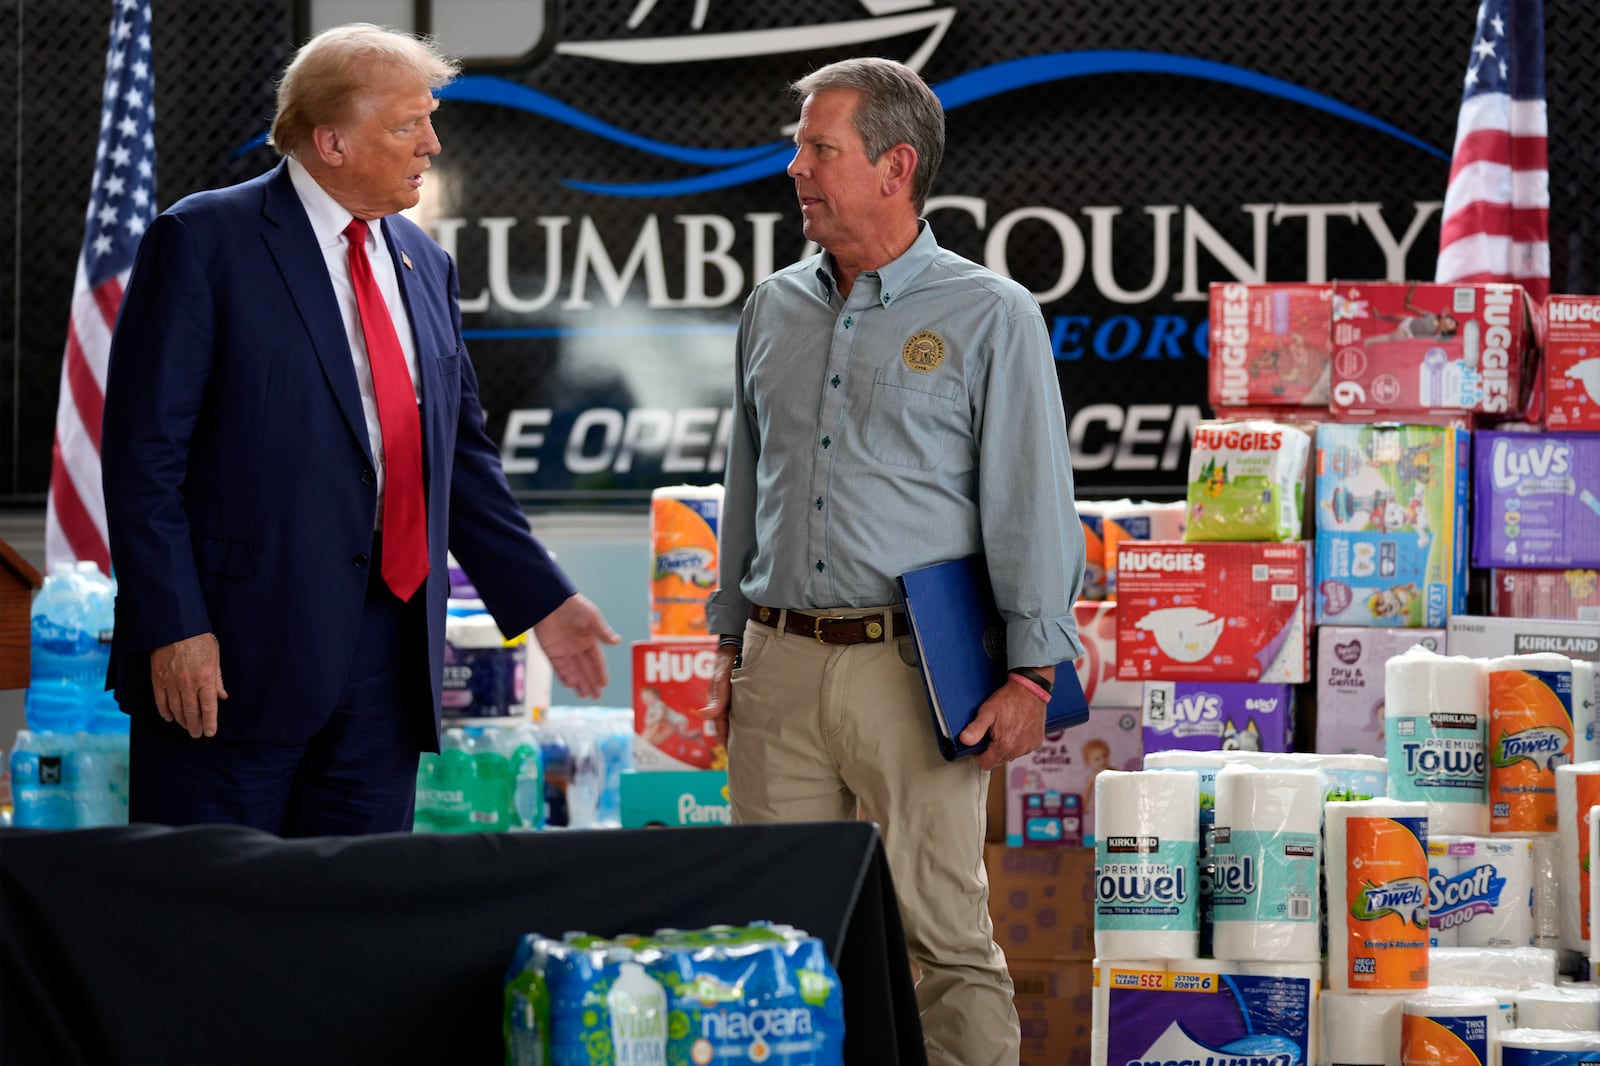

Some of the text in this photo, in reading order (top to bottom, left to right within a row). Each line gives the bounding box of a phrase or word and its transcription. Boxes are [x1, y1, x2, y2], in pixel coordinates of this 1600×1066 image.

[435, 213, 820, 314] LUMBI
[1549, 302, 1600, 322] HUGG
[1221, 285, 1249, 406] HUGGIES
[1483, 283, 1513, 413] HUGGIES
[1334, 381, 1366, 407] 6
[1193, 429, 1282, 451] HUGGIES
[1118, 551, 1205, 572] HUGGIES
[1518, 636, 1599, 653] KIRKLAND
[645, 651, 717, 682] HUG
[1328, 678, 1365, 687] Gentle
[1156, 695, 1220, 732] uvs
[1432, 714, 1476, 724] KIRKLAND
[1427, 739, 1482, 749] PREMIUM
[1502, 736, 1560, 761] Towels
[1403, 743, 1485, 774] Towe
[678, 793, 732, 824] Pam
[1109, 838, 1157, 847] KIRKLAND
[1105, 865, 1166, 875] PREMIUM
[1215, 857, 1253, 890] wel
[1365, 886, 1422, 913] Towels
[1429, 865, 1493, 911] Scott
[1438, 907, 1474, 930] 1000
[1364, 941, 1387, 949] Strong
[1354, 965, 1375, 973] ROLL
[1115, 974, 1210, 990] 9 LARGE 235 SHEETS
[701, 1007, 812, 1039] niagara
